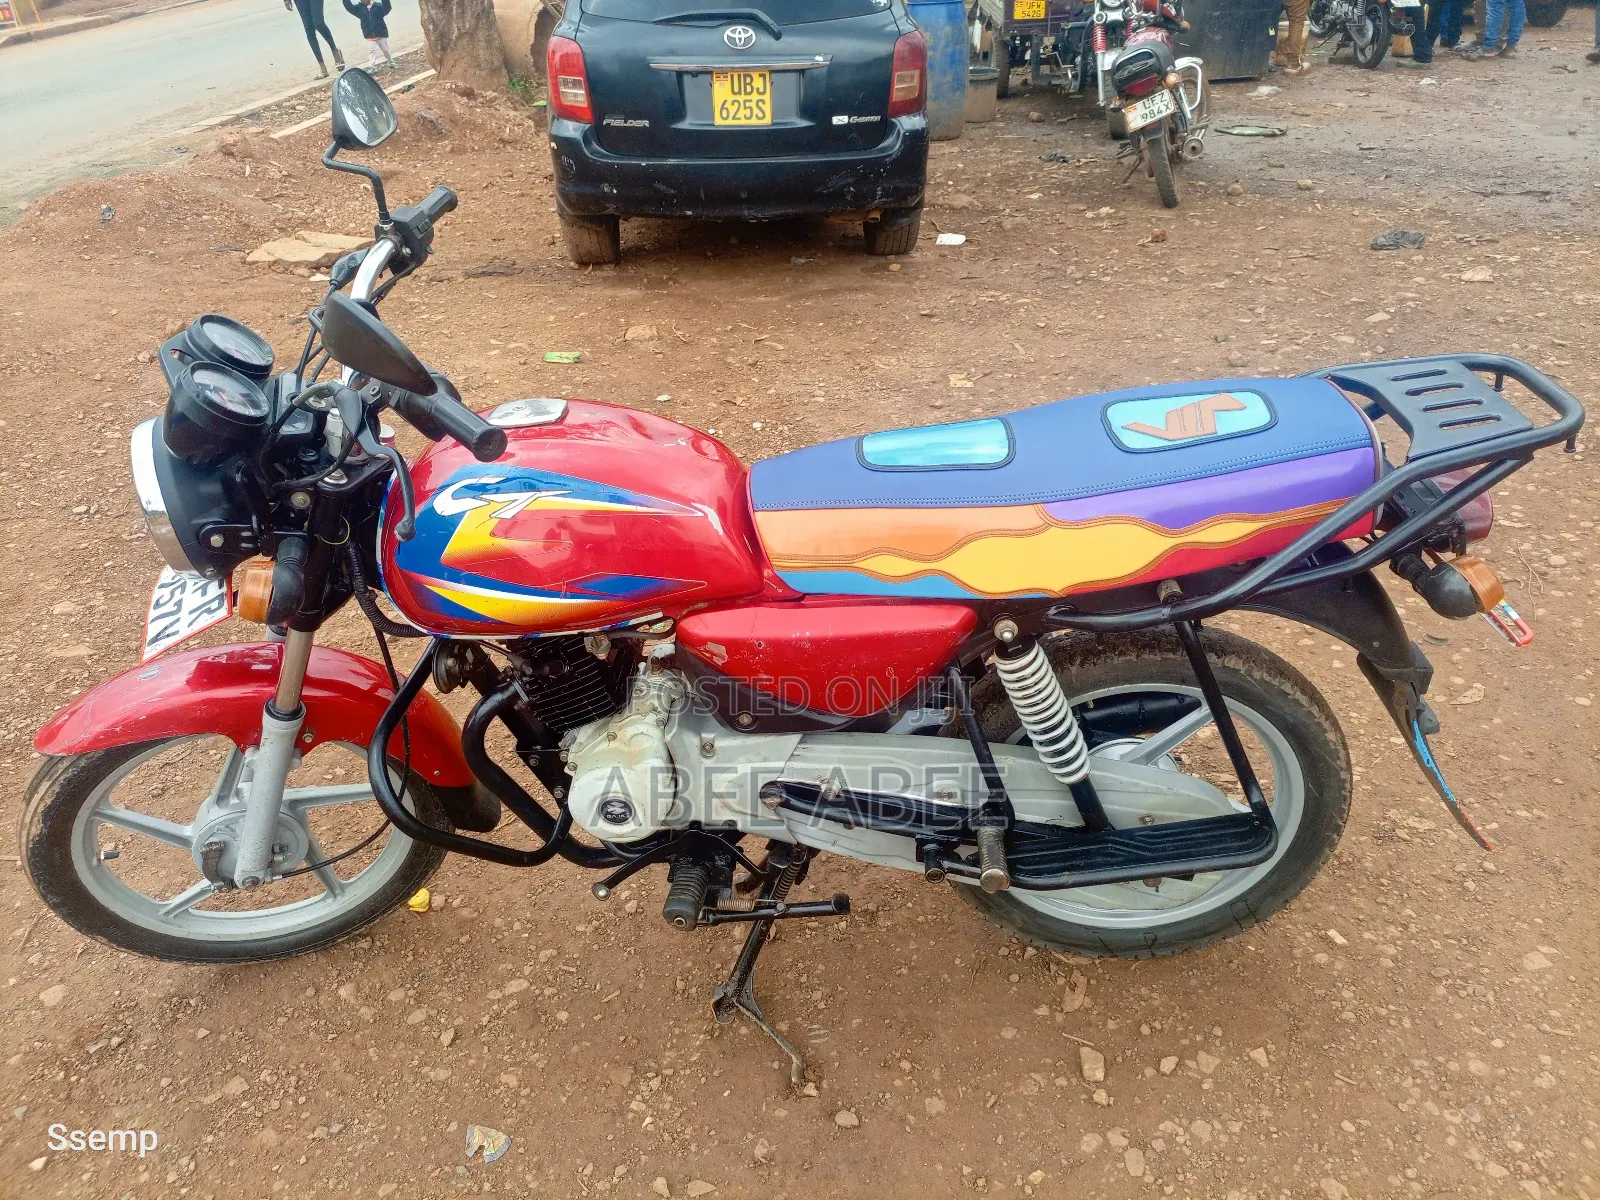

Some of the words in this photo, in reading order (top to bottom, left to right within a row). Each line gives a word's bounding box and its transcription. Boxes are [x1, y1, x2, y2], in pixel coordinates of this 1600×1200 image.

[730, 73, 767, 96] UBJ
[719, 98, 767, 121] 625S
[1141, 101, 1172, 122] 984X
[602, 119, 650, 128] FIELDER
[186, 576, 226, 629] FR
